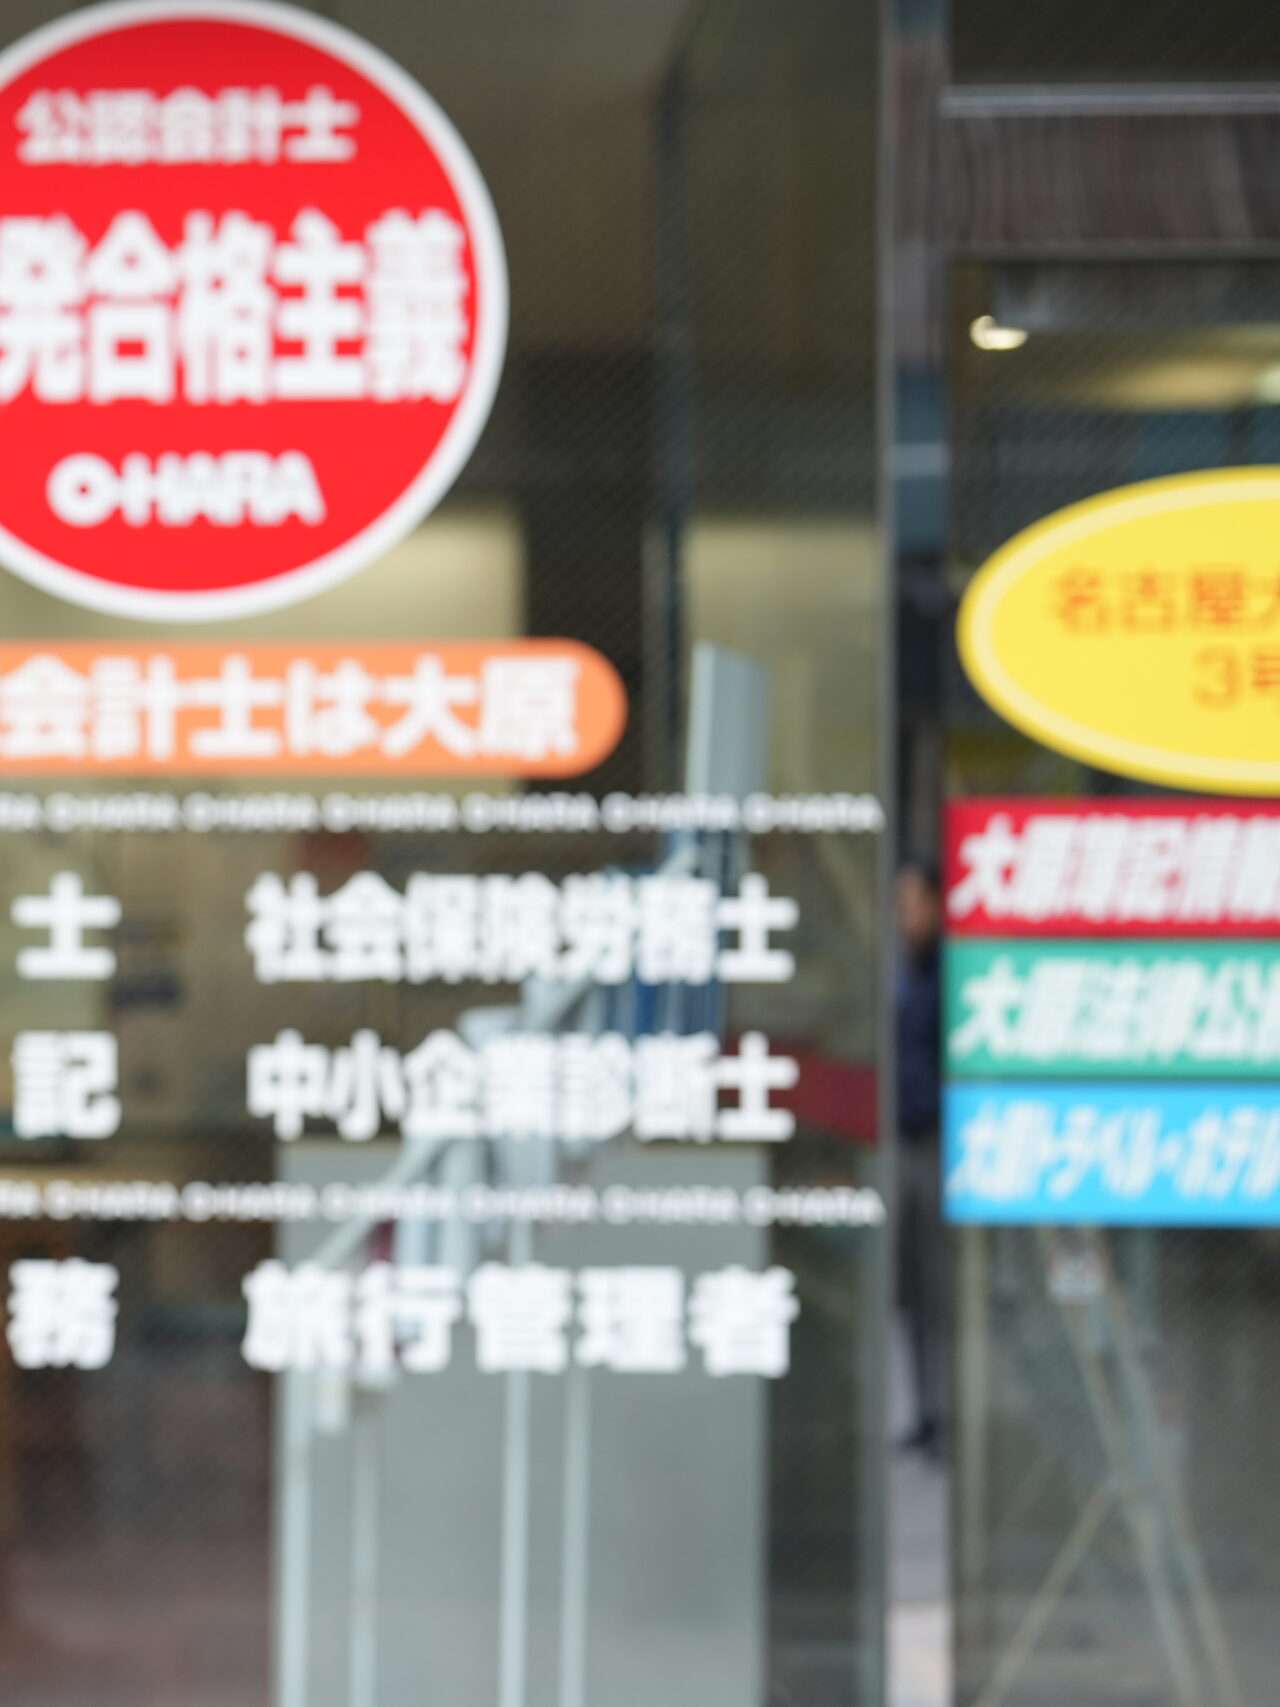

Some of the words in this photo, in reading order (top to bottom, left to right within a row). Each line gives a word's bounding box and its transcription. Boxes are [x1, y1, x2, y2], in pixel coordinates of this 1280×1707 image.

[15, 87, 359, 164] 公認会計士
[245, 871, 799, 984] 社会保険労務士
[246, 1029, 799, 1142] 中小企業診断士
[242, 1259, 800, 1376] 旅行管理者
